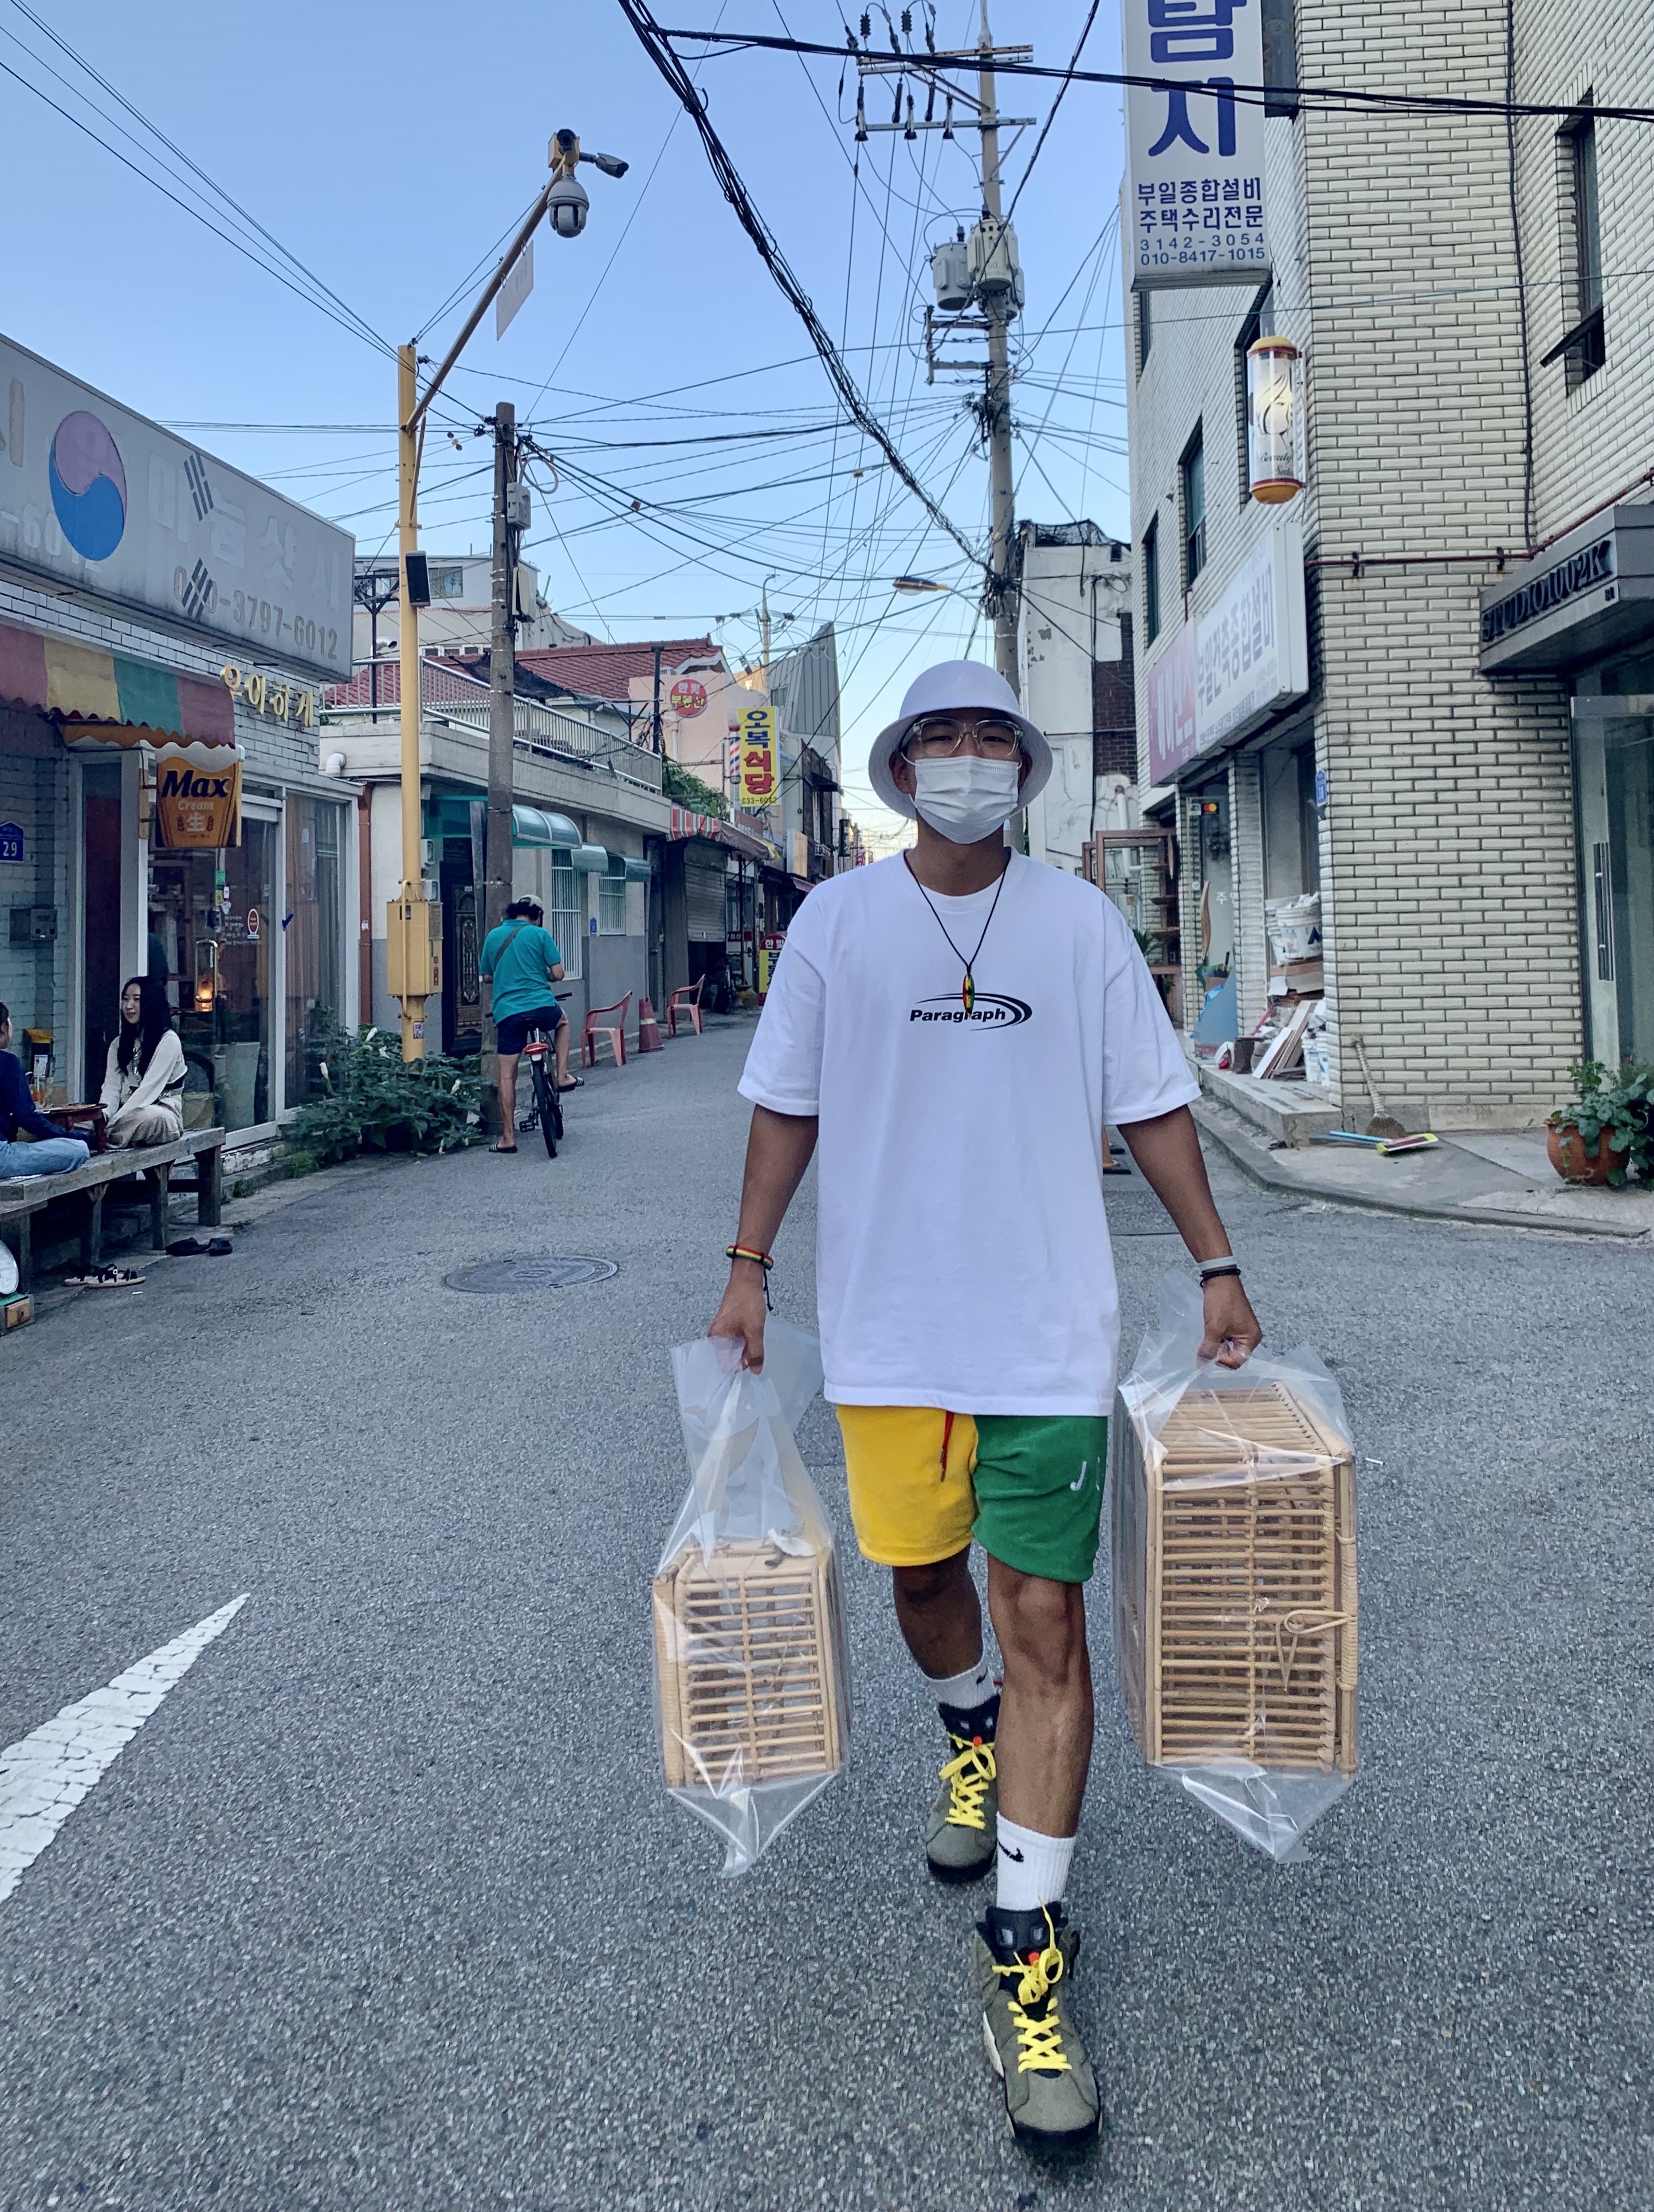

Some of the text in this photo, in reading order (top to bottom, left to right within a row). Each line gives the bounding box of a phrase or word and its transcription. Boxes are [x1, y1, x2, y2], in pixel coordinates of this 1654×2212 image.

[1138, 176, 1262, 207] 부일종합설비
[1140, 204, 1263, 233] 주택수리전문
[1140, 233, 1264, 251] 3142-3054
[1141, 247, 1266, 266] 010-8417-1015
[174, 565, 337, 660] 00-3797-6012
[1197, 562, 1275, 716] 부일건축종합설비
[671, 694, 705, 709] 부동산
[743, 710, 775, 795] 오복식당
[161, 770, 230, 798] Max
[186, 812, 205, 832] 生
[3, 841, 17, 857] 29
